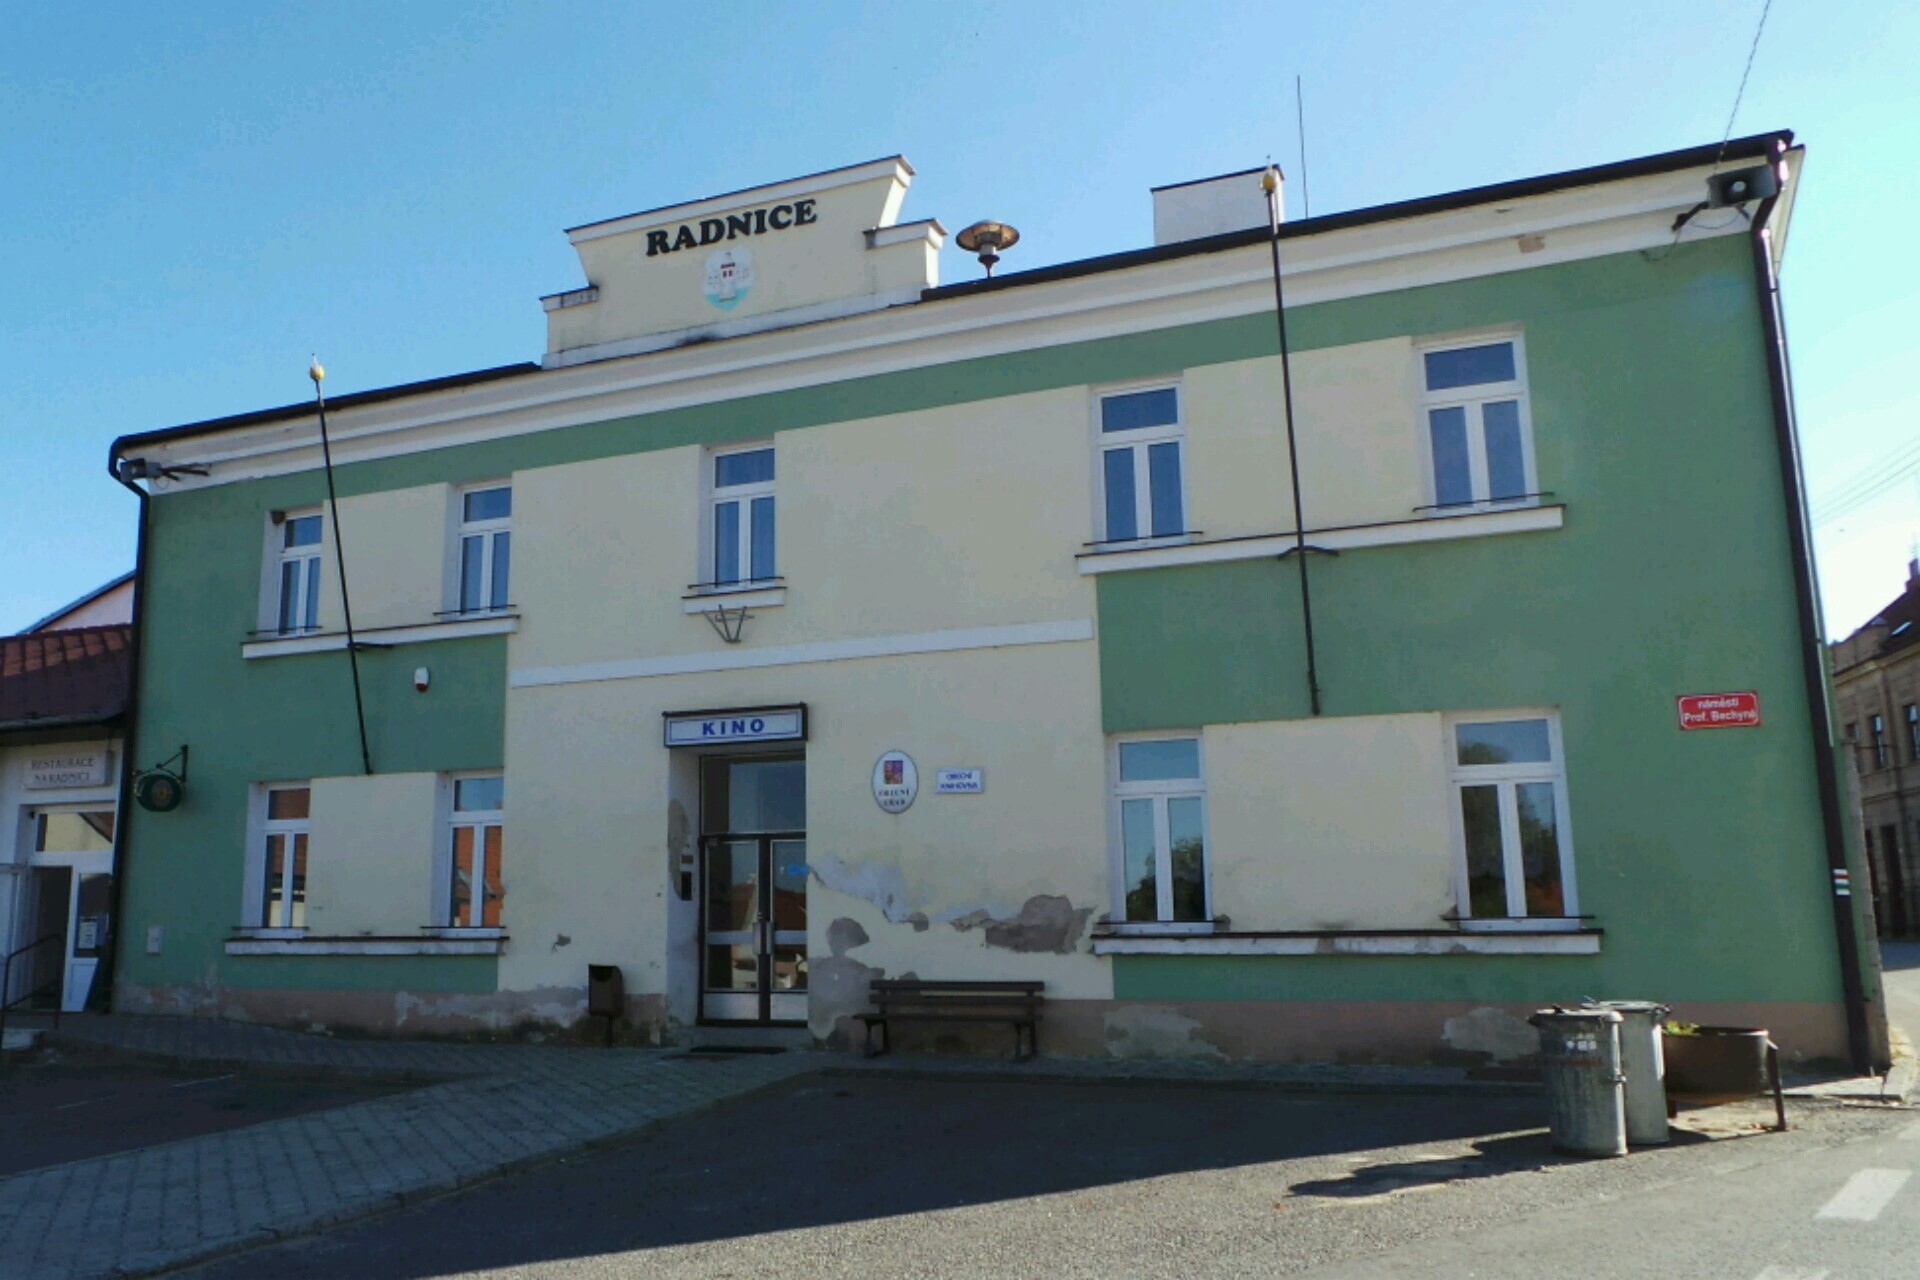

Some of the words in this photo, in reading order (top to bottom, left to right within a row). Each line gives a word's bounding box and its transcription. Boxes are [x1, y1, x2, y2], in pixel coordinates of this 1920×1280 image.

[646, 199, 818, 257] RADNICE
[702, 718, 765, 736] KINO
[31, 757, 95, 770] RESTAURACE
